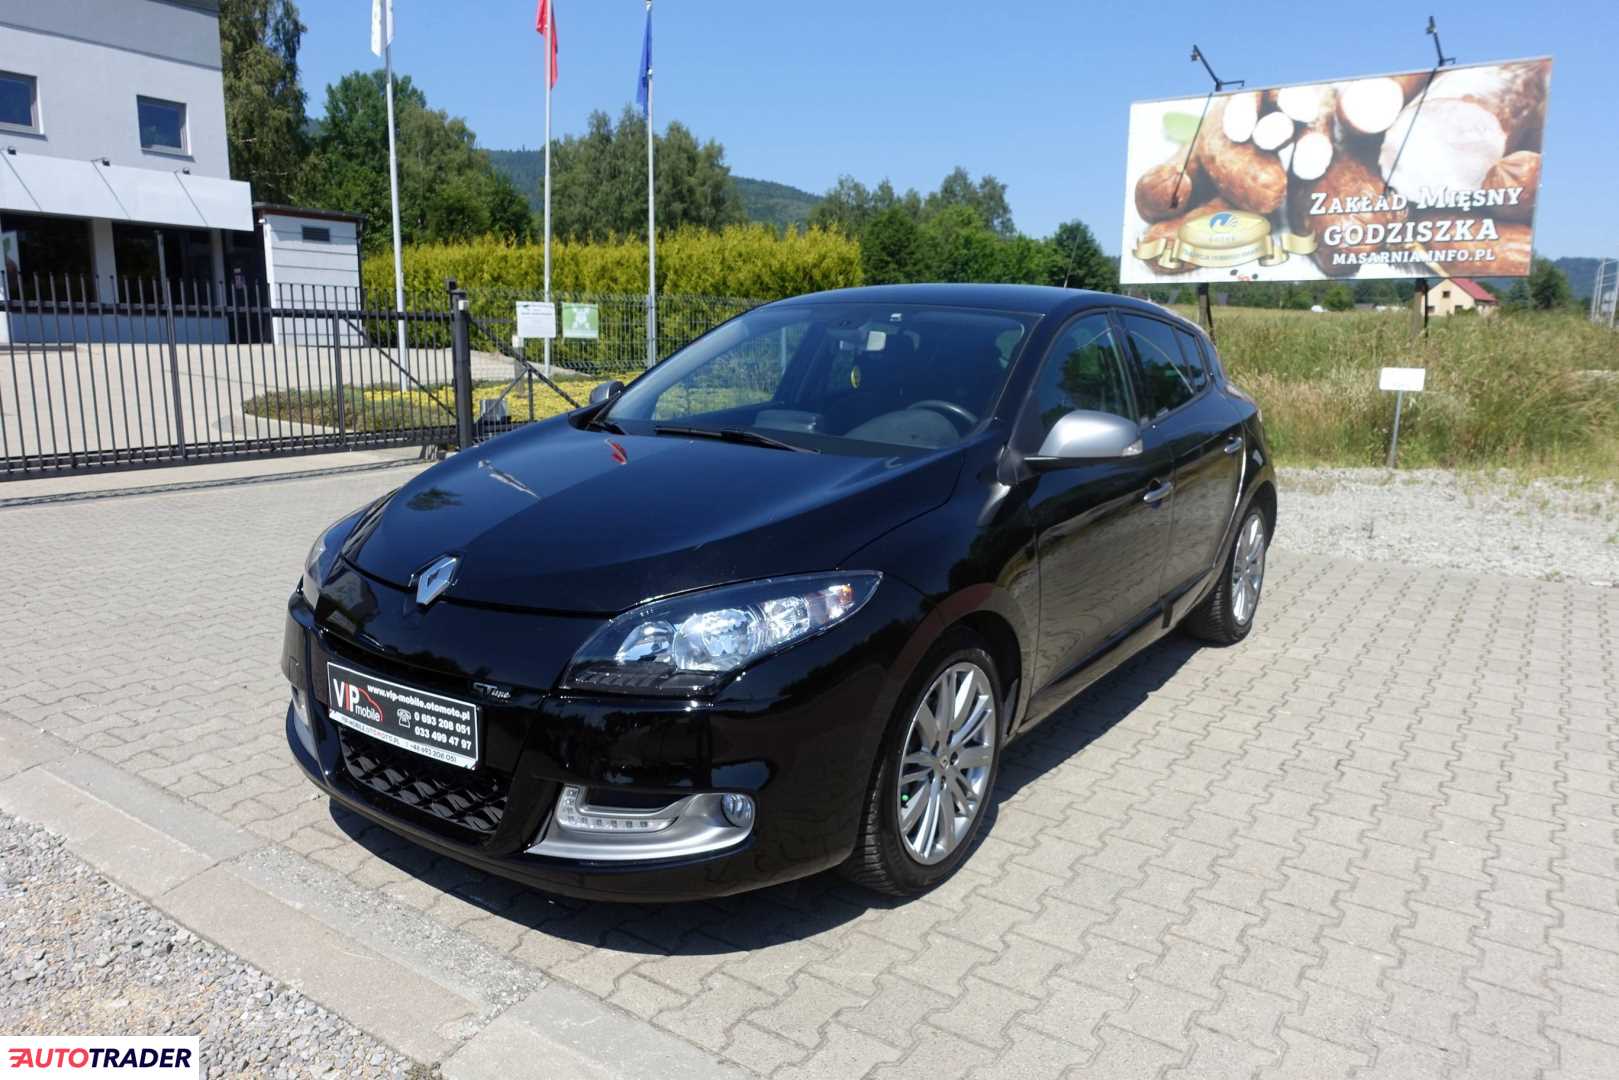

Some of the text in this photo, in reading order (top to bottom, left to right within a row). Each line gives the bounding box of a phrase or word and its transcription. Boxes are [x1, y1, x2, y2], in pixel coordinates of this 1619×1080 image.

[1309, 187, 1523, 215] ZAKŁAD MIĘSNY
[1323, 218, 1499, 246] GODZISZKA
[333, 678, 360, 713] VIP
[367, 684, 471, 721] www.vip-mobile.otomoto.pl
[355, 704, 381, 722] mobile
[415, 726, 472, 750] 033 499 47 97
